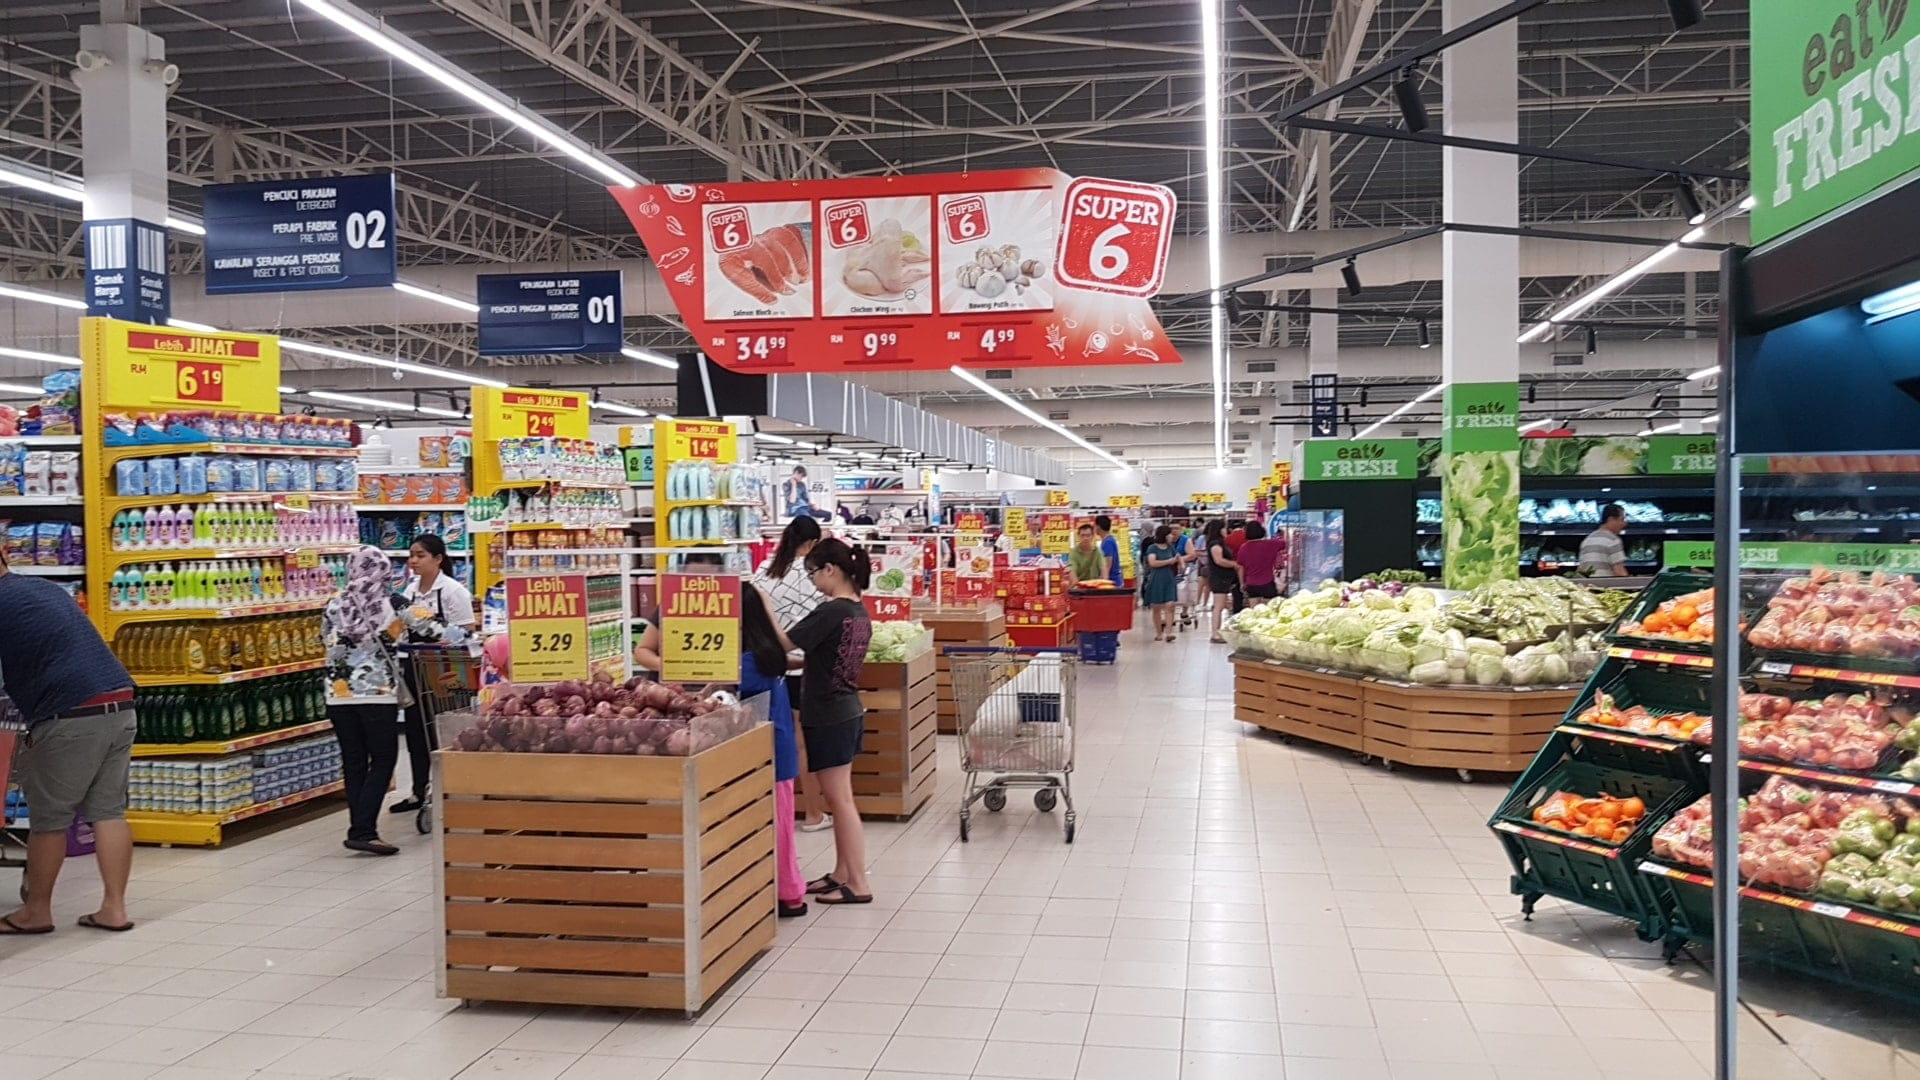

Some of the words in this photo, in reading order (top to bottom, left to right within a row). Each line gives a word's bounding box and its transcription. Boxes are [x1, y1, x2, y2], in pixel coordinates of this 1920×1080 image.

[829, 206, 862, 221] SUPER
[948, 202, 982, 216] SUPER
[1075, 194, 1160, 226] SUPER
[711, 212, 745, 226] SUPER
[959, 213, 976, 237] 6
[346, 211, 387, 250] 02
[724, 223, 740, 246] 6
[841, 218, 857, 242] 6
[1089, 222, 1131, 279] 6
[587, 295, 615, 324] 01
[712, 338, 725, 347] RM
[830, 334, 844, 343] RM
[947, 331, 960, 340] RM
[154, 339, 184, 351] Lebih
[187, 337, 235, 356] JIMAT
[131, 364, 147, 374] RM
[536, 395, 564, 407] JIMAT
[1468, 401, 1493, 414] eat
[1455, 414, 1516, 428] FRESH
[1337, 443, 1370, 459] eat
[1321, 459, 1398, 477] FRESH
[1837, 550, 1870, 566] eat
[527, 576, 566, 593] Lebih
[681, 575, 720, 592] Lebih
[515, 593, 580, 617] JIMAT
[667, 592, 734, 616] JIMAT
[530, 633, 573, 653] 3.29
[682, 633, 725, 651] 3.29
